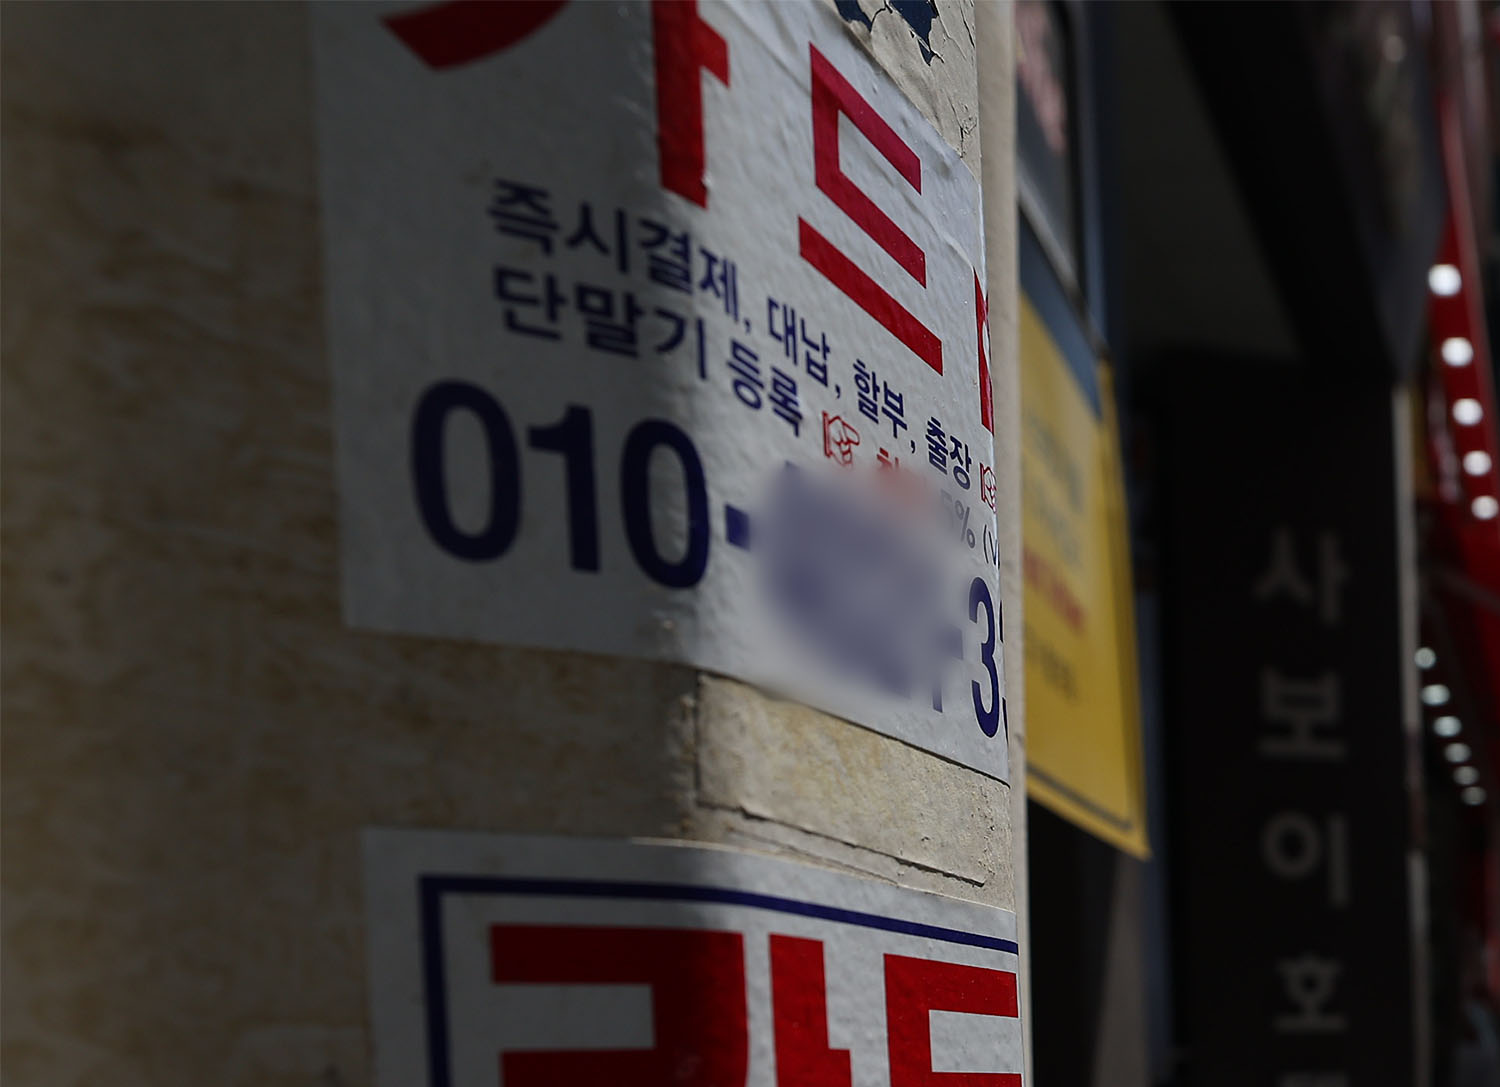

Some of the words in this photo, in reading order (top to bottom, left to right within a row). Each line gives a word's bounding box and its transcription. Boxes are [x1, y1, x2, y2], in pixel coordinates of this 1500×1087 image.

[488, 177, 751, 333] 즉시결제,
[767, 297, 841, 399] 대납,
[852, 359, 917, 455] 할부,
[925, 416, 972, 490] 출장
[492, 266, 708, 381] 단말기
[726, 339, 803, 437] 등록
